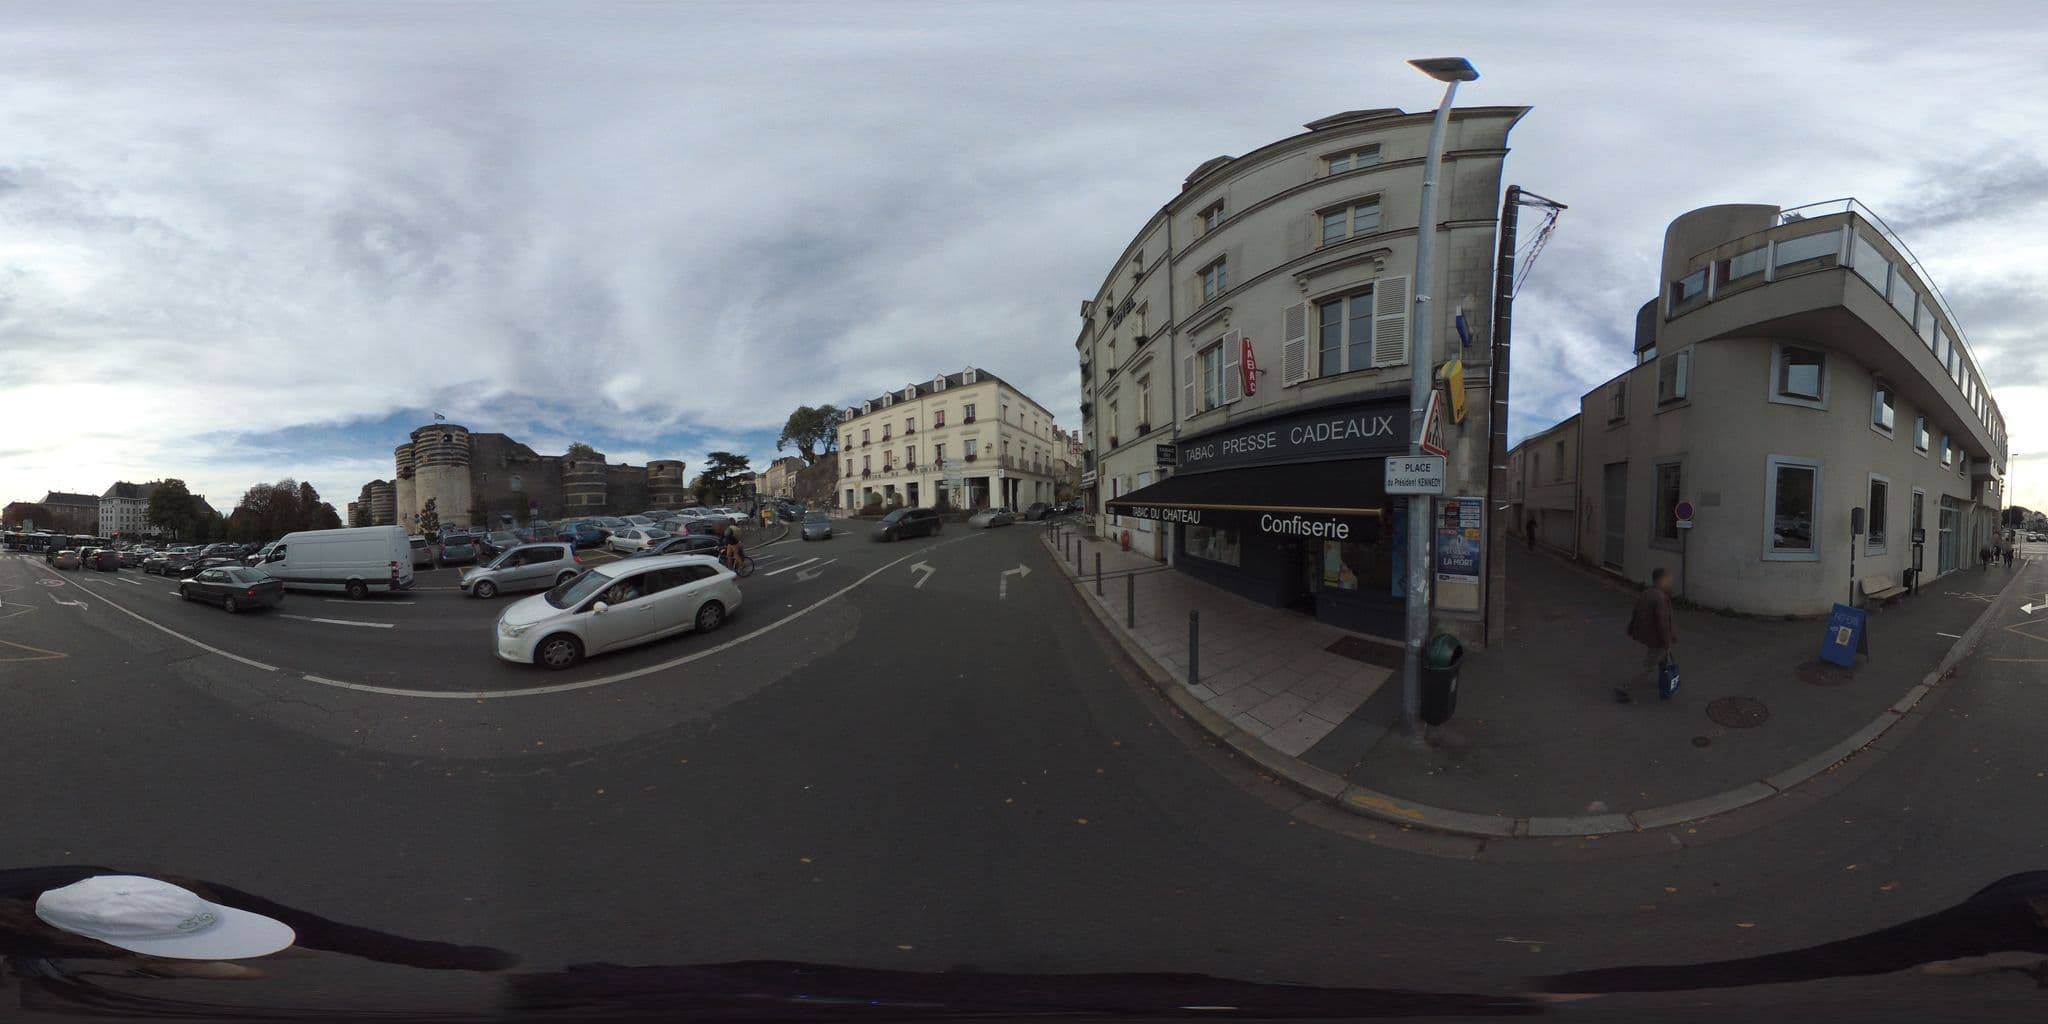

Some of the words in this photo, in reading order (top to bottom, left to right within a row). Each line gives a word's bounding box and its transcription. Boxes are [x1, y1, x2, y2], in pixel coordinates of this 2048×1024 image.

[1246, 338, 1257, 393] TABAC
[1186, 445, 1215, 462] TABAC
[1222, 431, 1277, 455] PRESSE
[1290, 415, 1394, 445] CADEAUX
[1404, 463, 1431, 473] PLACE
[1417, 477, 1441, 487] KENNEDY
[1132, 506, 1149, 518] TABAC
[1150, 507, 1160, 520] DU
[1162, 508, 1201, 525] CHATEAU
[1260, 514, 1350, 540] Confiserie
